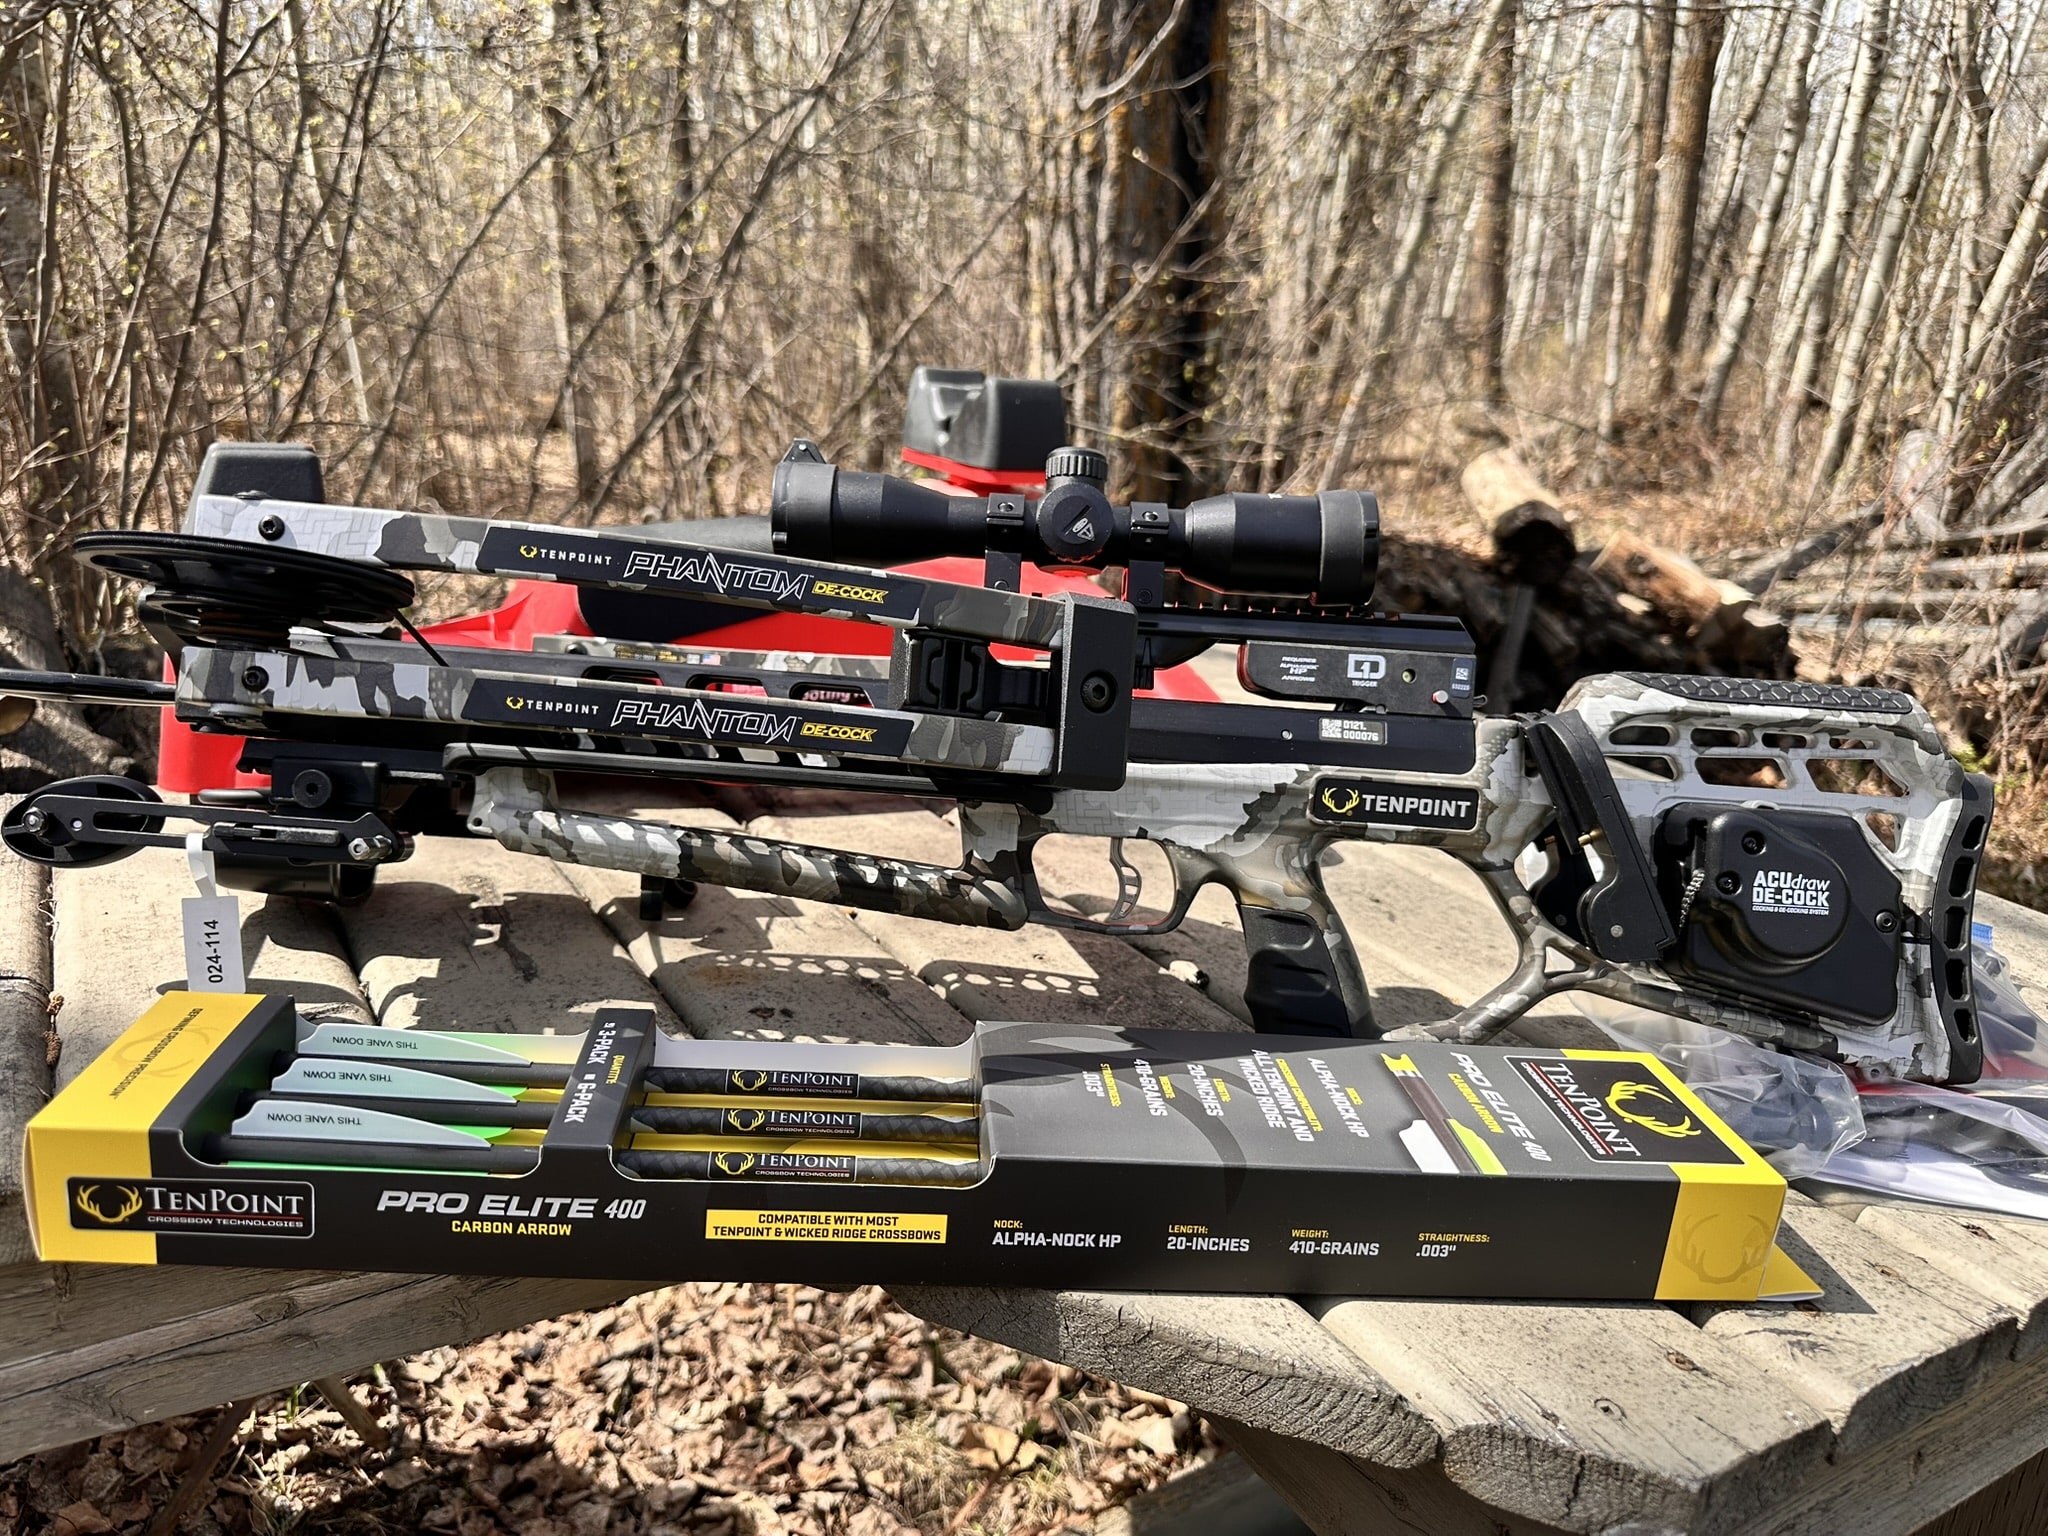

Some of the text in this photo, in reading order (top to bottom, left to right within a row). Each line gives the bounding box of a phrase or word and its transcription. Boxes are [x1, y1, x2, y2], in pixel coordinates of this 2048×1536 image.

[540, 548, 886, 603] TENPOINT PHANTOM DE-COCK
[1352, 680, 1378, 688] TRIGGER
[526, 699, 874, 744] TENPOINT PHANTOM DE-COCK
[1362, 794, 1471, 818] TENPOINT
[1753, 870, 1831, 891] ACUdraw
[1752, 887, 1830, 907] DE-COCK
[203, 920, 224, 983] 024-114
[332, 1036, 418, 1050] THIS VANE DOWN
[586, 1030, 617, 1064] 3-PACK
[1251, 1049, 1274, 1068] ALL
[303, 1070, 392, 1082] THIS VANE DOWN
[1134, 1058, 1168, 1117] 410-GRAINS
[1187, 1064, 1224, 1117] 20-INCHES
[1237, 1058, 1270, 1096] WICKED
[1256, 1096, 1288, 1129] RIDGE
[1262, 1066, 1302, 1117] TENPOINT
[1307, 1057, 1360, 1120] ALPHA-NOCK
[1345, 1121, 1370, 1138] HP
[564, 1083, 597, 1124] 6-PACK
[1448, 1073, 1504, 1133] CARBON ARROW
[1450, 1051, 1552, 1162] PRO ELITE 400
[1520, 1062, 1606, 1155] CROSSBOW TECHNOLOGIES
[267, 1112, 362, 1126] THIS VANE DOWN
[1286, 1116, 1315, 1142] AND
[377, 1190, 647, 1220] PRO ELITE 400
[147, 1216, 304, 1228] CROSSBOW TECHNOLOGIES
[451, 1220, 572, 1236] CARBON ARROW
[758, 1214, 899, 1226] COMPATIBLE WITH MOST
[993, 1219, 1023, 1229] NOCK:
[1168, 1224, 1208, 1235] LENGTH:
[713, 1226, 942, 1240] TENPOINT & WICKED RIDGE CROSSBOWS
[992, 1231, 1122, 1248] ALPHA-NOCK HP
[1291, 1228, 1330, 1239] WEIGHT:
[1418, 1232, 1490, 1243] STRAIGHTNESS:
[1166, 1236, 1250, 1252] 20-INCHES
[1288, 1240, 1380, 1256] 410-GRAINS
[1415, 1244, 1457, 1258] .003"
